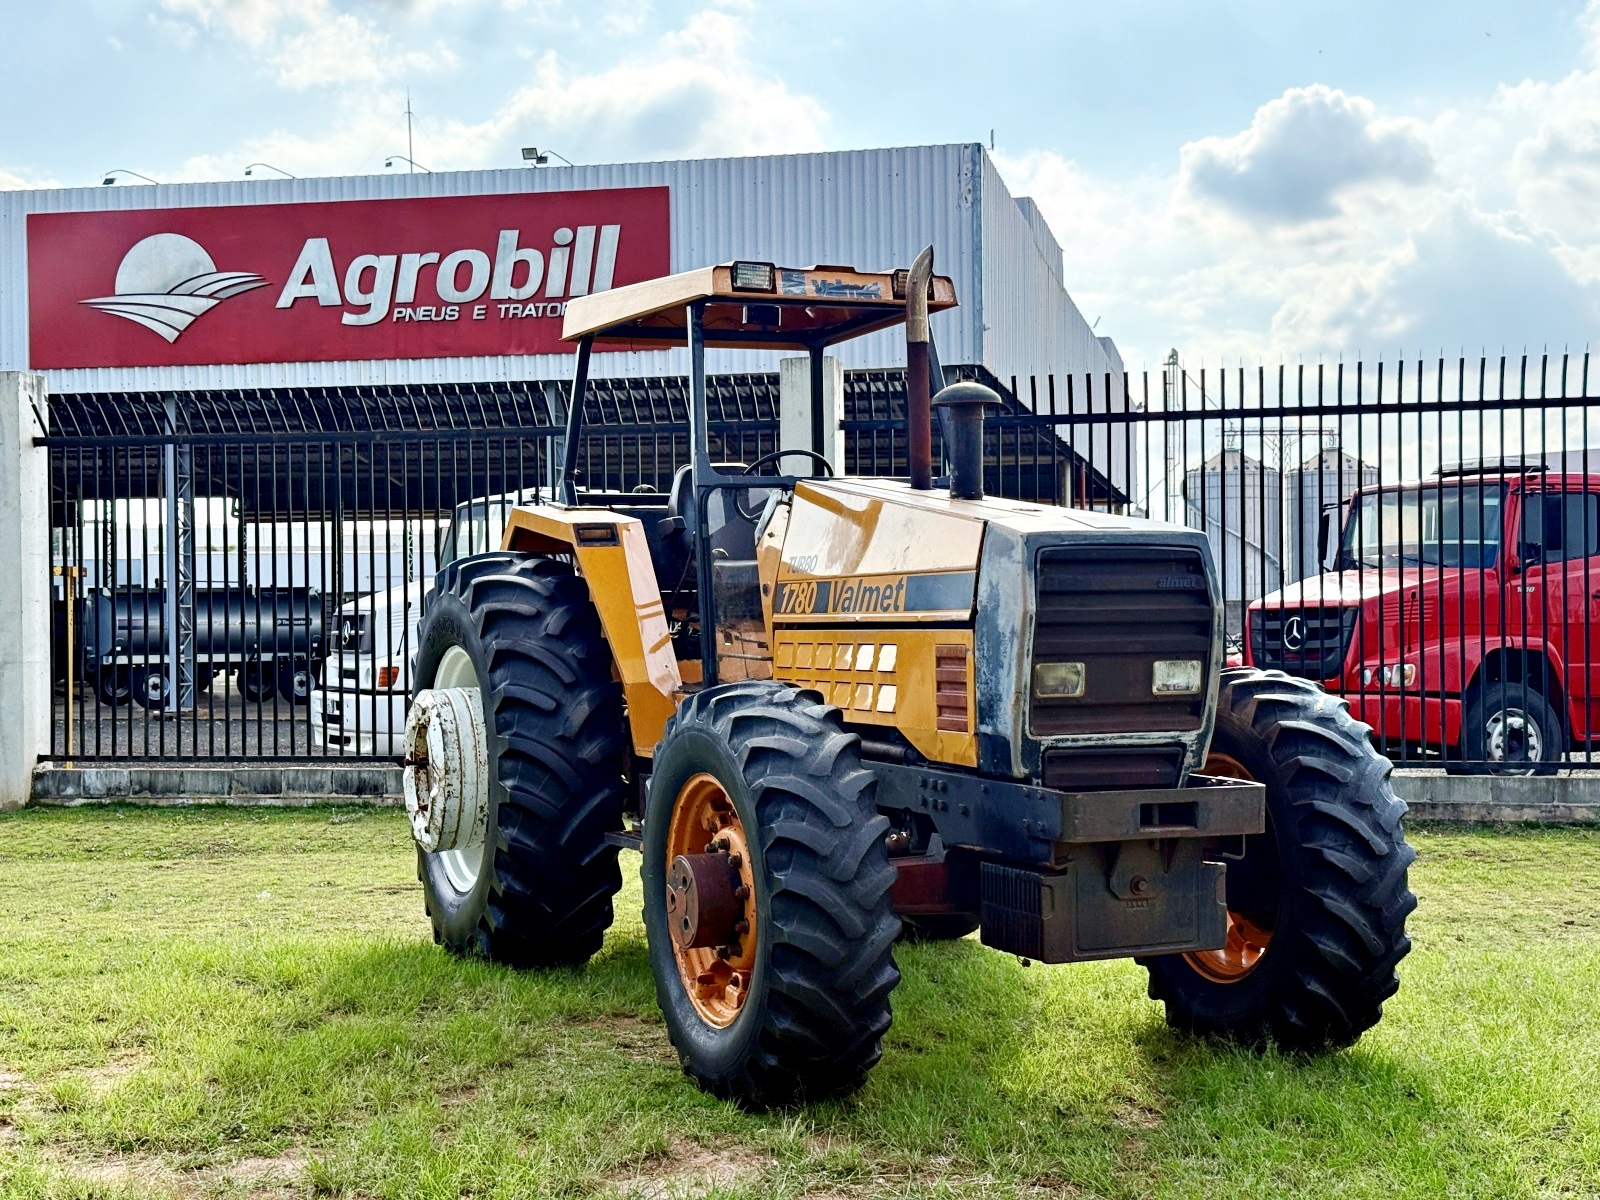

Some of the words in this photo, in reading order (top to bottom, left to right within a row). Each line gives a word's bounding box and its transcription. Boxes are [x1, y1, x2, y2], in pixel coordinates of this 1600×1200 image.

[275, 224, 621, 326] Agrobill
[393, 305, 460, 323] PNEUS
[472, 304, 487, 320] E
[787, 554, 818, 573] TURBO
[780, 581, 818, 614] 1780
[831, 576, 904, 613] Valmet
